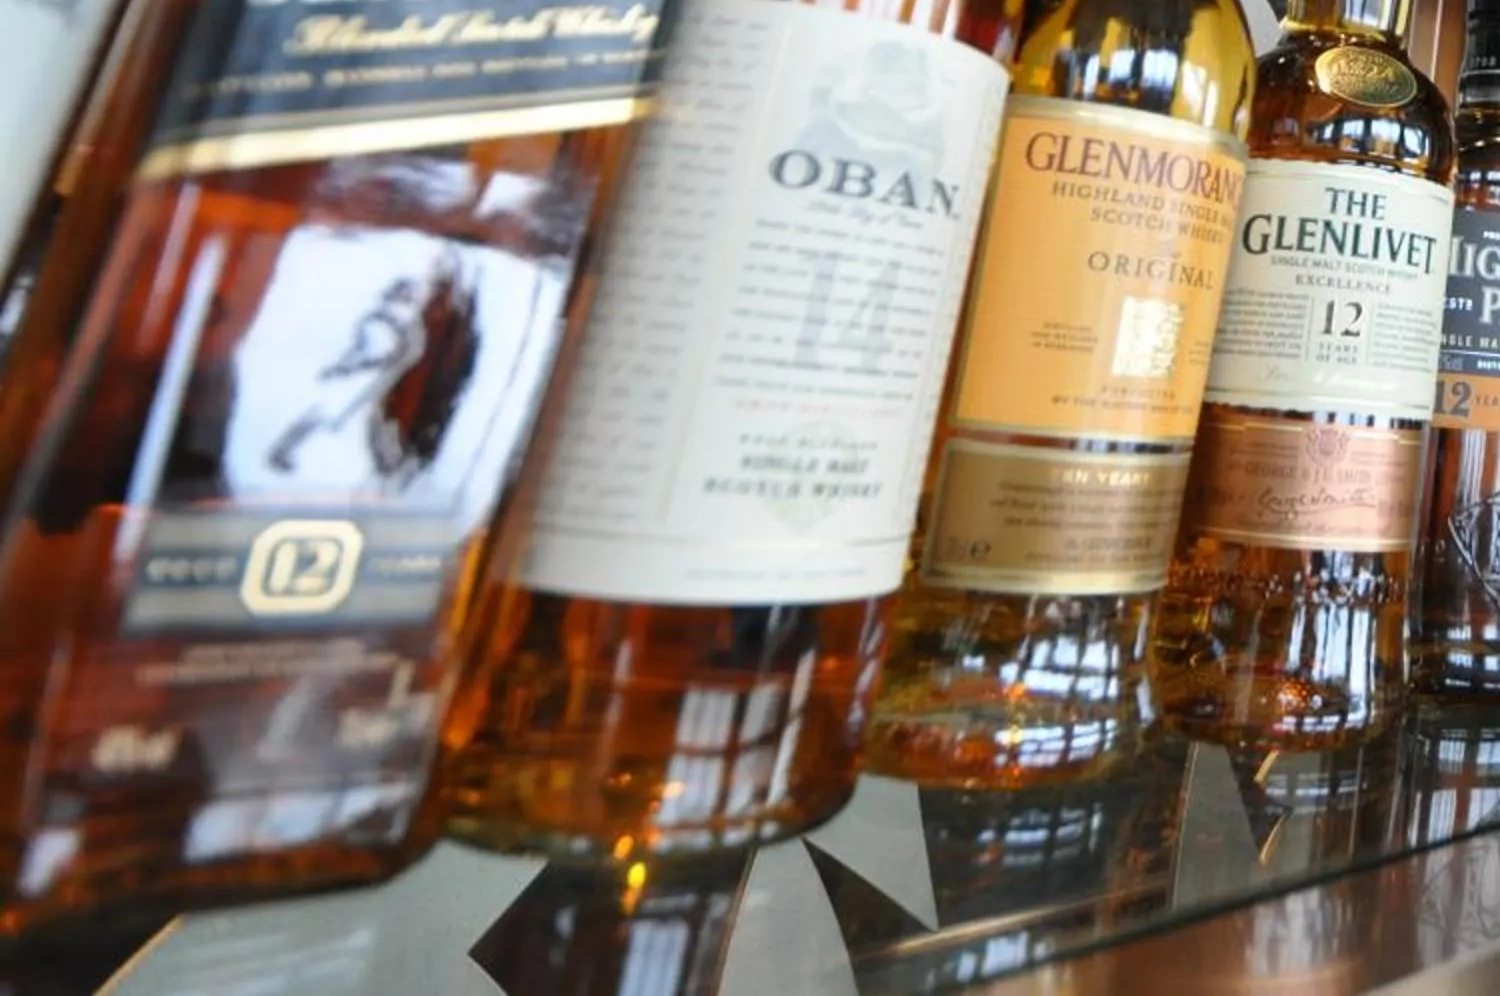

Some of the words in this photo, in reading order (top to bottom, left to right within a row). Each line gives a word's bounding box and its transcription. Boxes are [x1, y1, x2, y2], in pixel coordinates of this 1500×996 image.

[767, 148, 962, 221] OBAN
[1024, 131, 1241, 210] GLENMORAN
[1052, 180, 1165, 211] HIGHLAND
[1325, 186, 1388, 221] THE
[1090, 207, 1170, 233] SCOTCH
[1241, 213, 1438, 275] GLENLIVET
[1270, 255, 1308, 268] SINGLE
[1312, 258, 1342, 270] MALT
[1087, 251, 1214, 290] ORIGINAL
[1295, 274, 1391, 295] EXCELLENCE
[1321, 299, 1363, 337] 12
[1433, 379, 1473, 418] 12
[269, 539, 342, 596] 12
